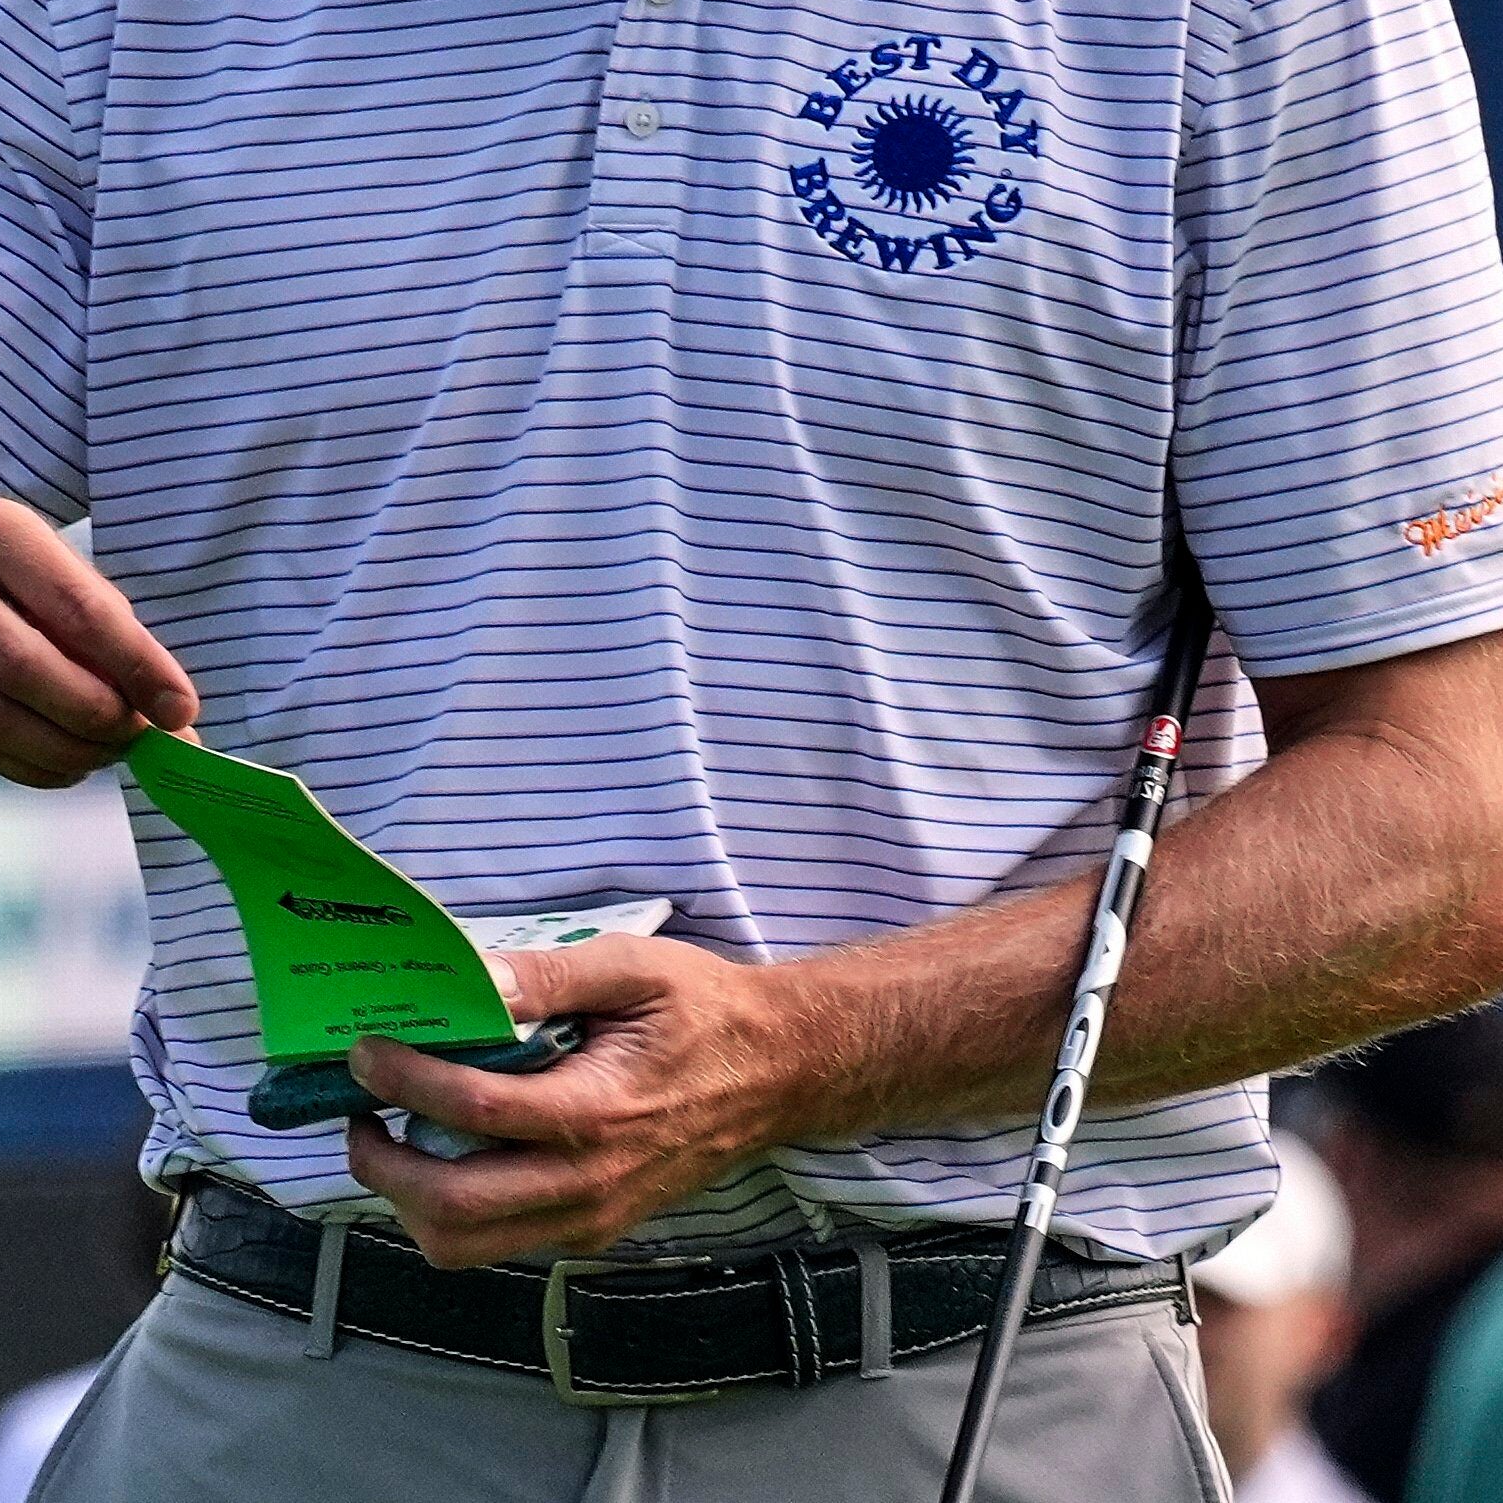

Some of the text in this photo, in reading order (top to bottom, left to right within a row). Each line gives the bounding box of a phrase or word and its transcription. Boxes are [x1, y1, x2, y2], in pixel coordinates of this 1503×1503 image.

[798, 35, 1039, 159] BEST DAY
[789, 157, 1023, 274] BREWING
